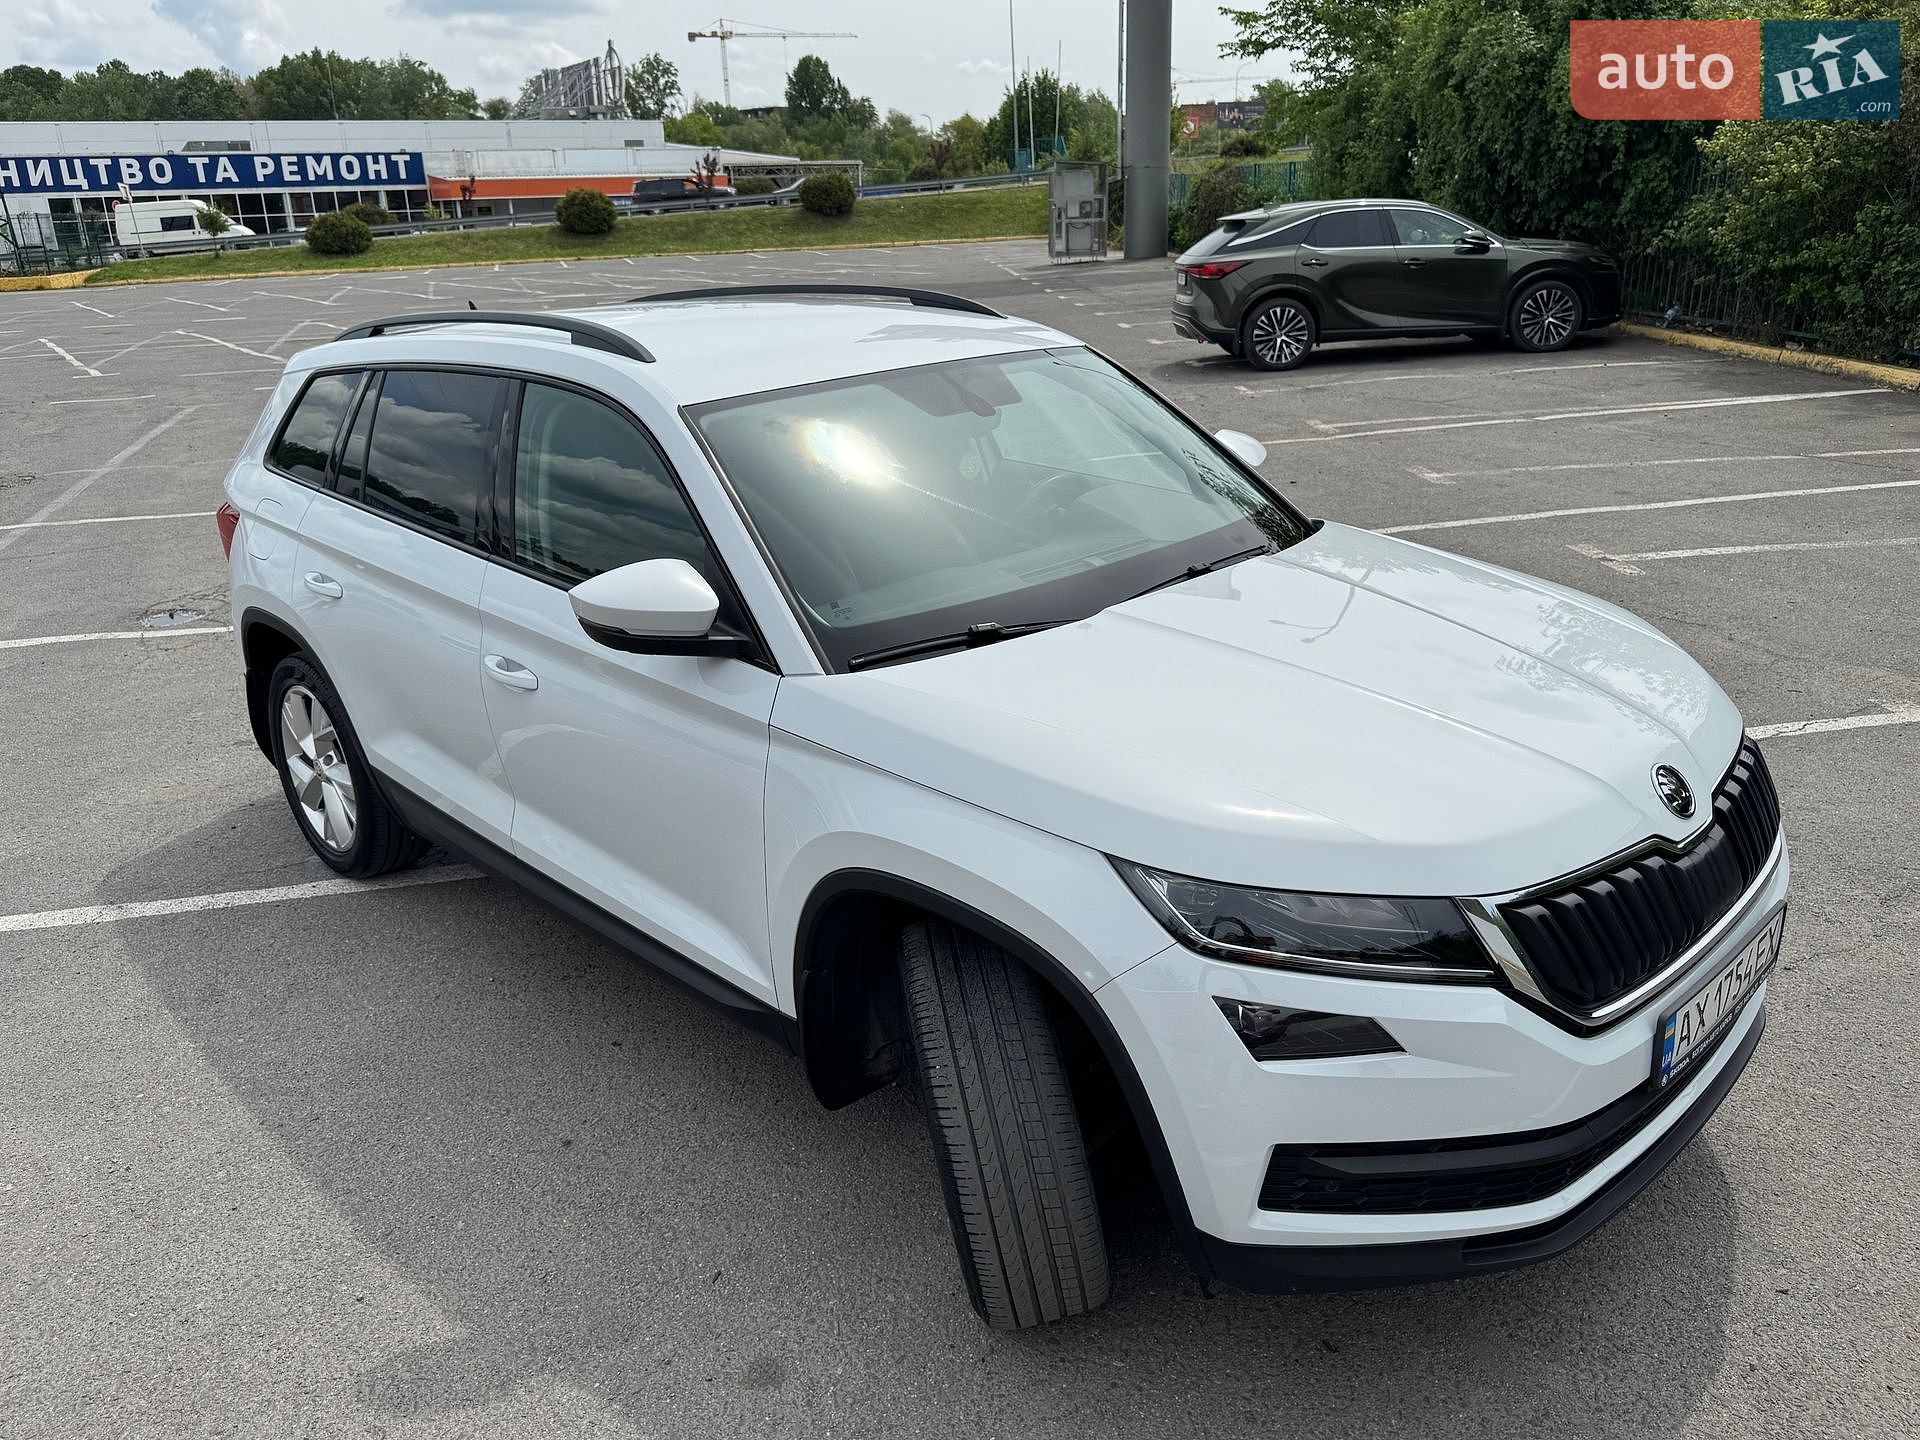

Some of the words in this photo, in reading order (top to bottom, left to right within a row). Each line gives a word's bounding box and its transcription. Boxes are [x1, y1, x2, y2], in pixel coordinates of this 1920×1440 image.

[0, 157, 173, 190] НИЦТВО
[188, 156, 240, 183] ТА
[253, 154, 411, 182] РЕМОНТ
[1675, 991, 1710, 1057] AX
[1714, 946, 1753, 1018] 1754
[1754, 918, 1780, 977] EX
